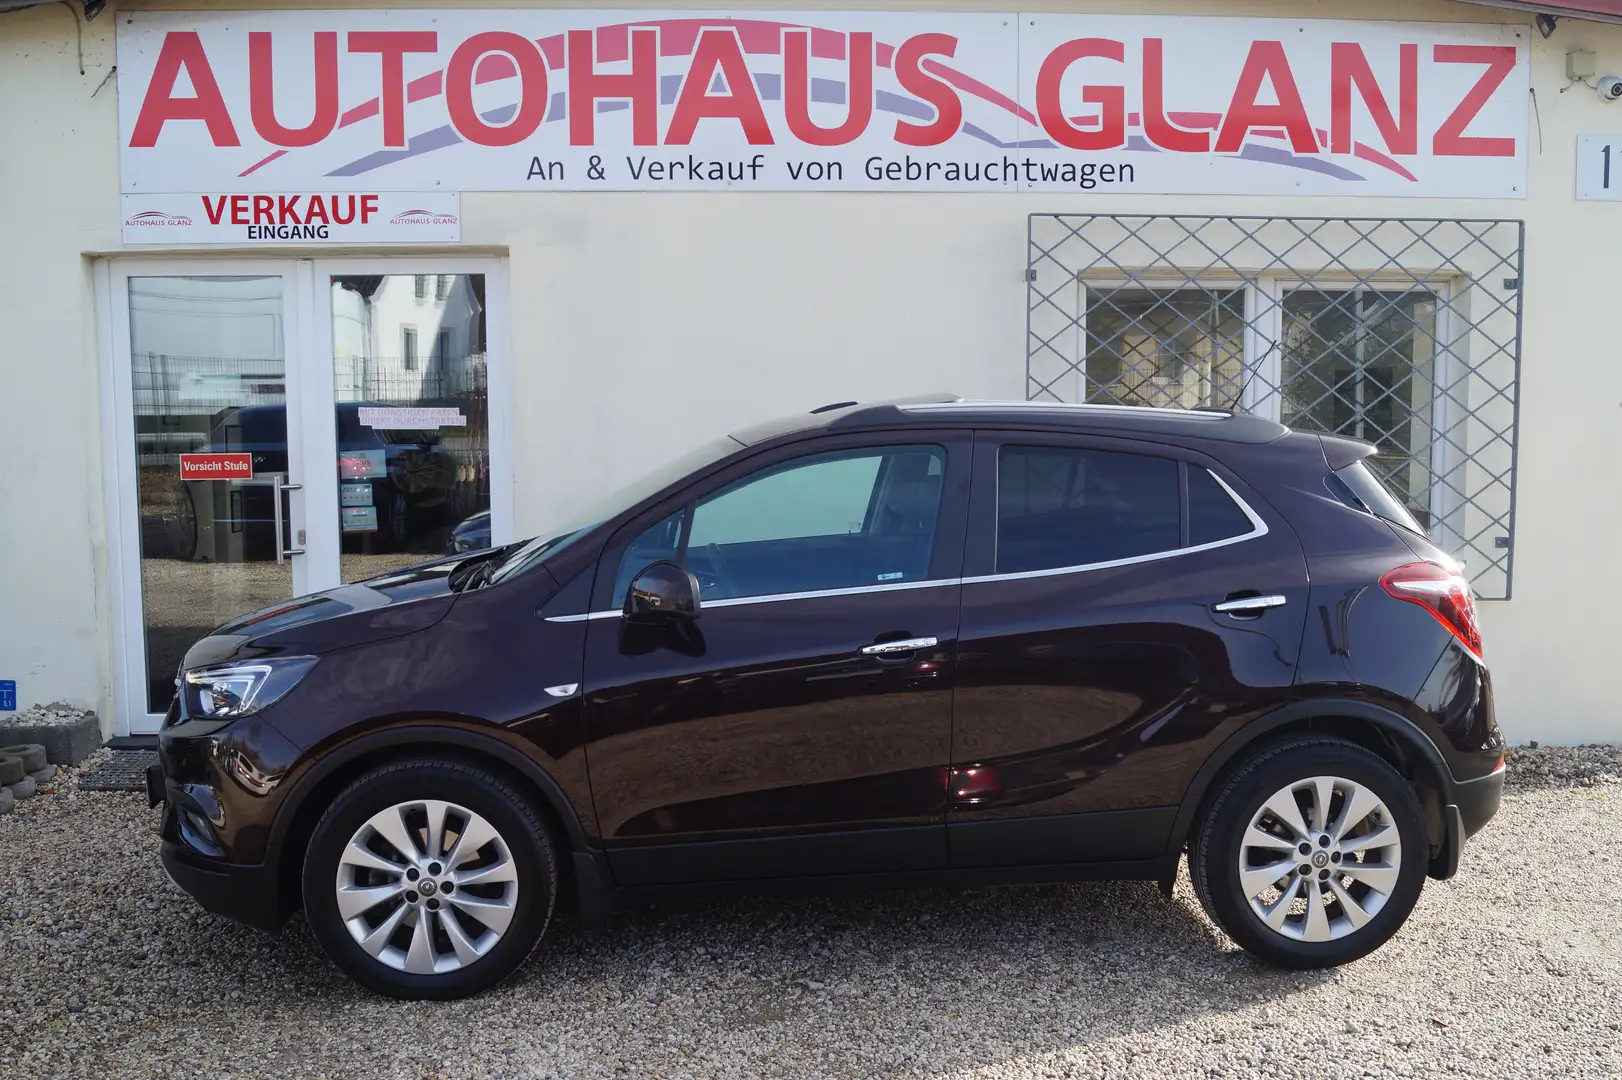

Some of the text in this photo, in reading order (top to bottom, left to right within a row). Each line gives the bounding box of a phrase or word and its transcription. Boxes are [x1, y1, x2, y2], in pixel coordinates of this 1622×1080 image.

[129, 30, 1516, 157] AUTOHAUS GLANZ
[527, 155, 1134, 189] An & Verkauf von Gebrauchtwagen
[1601, 144, 1622, 189] 1
[201, 195, 379, 225] VERKAUF
[247, 223, 329, 240] EINGANG
[360, 408, 375, 416] MIT
[431, 408, 458, 416] RATEN
[184, 460, 249, 471] Vorsicht Stufe
